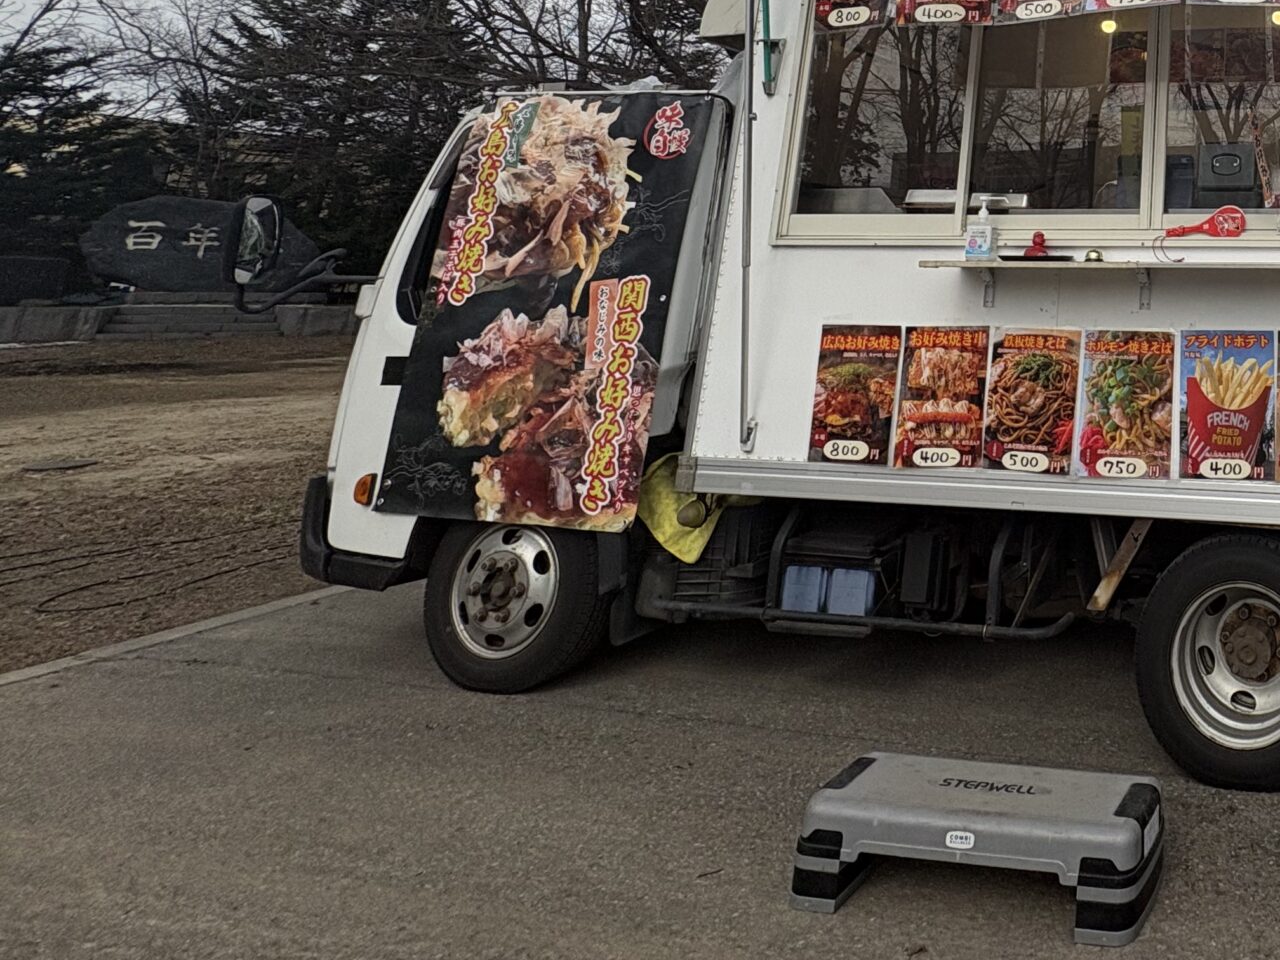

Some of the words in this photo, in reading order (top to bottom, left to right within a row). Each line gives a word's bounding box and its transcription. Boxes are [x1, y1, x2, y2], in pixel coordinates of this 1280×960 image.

[834, 9, 861, 22] 800
[1023, 3, 1053, 16] 500
[450, 102, 520, 303] 広島お好み焼き
[592, 287, 609, 362] おなじみの味
[822, 335, 901, 351] 広島お好み焼き
[1003, 334, 1067, 350] 鉄板焼きそば
[1086, 340, 1173, 355] ホルモン焼きそば
[1184, 333, 1270, 349] フライドポテト
[581, 277, 648, 512] 関西お好み焼き
[1206, 411, 1250, 431] FRENCH
[1216, 427, 1239, 436] FRIED
[1211, 434, 1242, 445] POTATO
[830, 442, 860, 456] 800
[1009, 455, 1039, 468] 500
[1103, 460, 1137, 474] 750
[1209, 462, 1242, 476] 400
[938, 777, 1037, 795] STEPWELL
